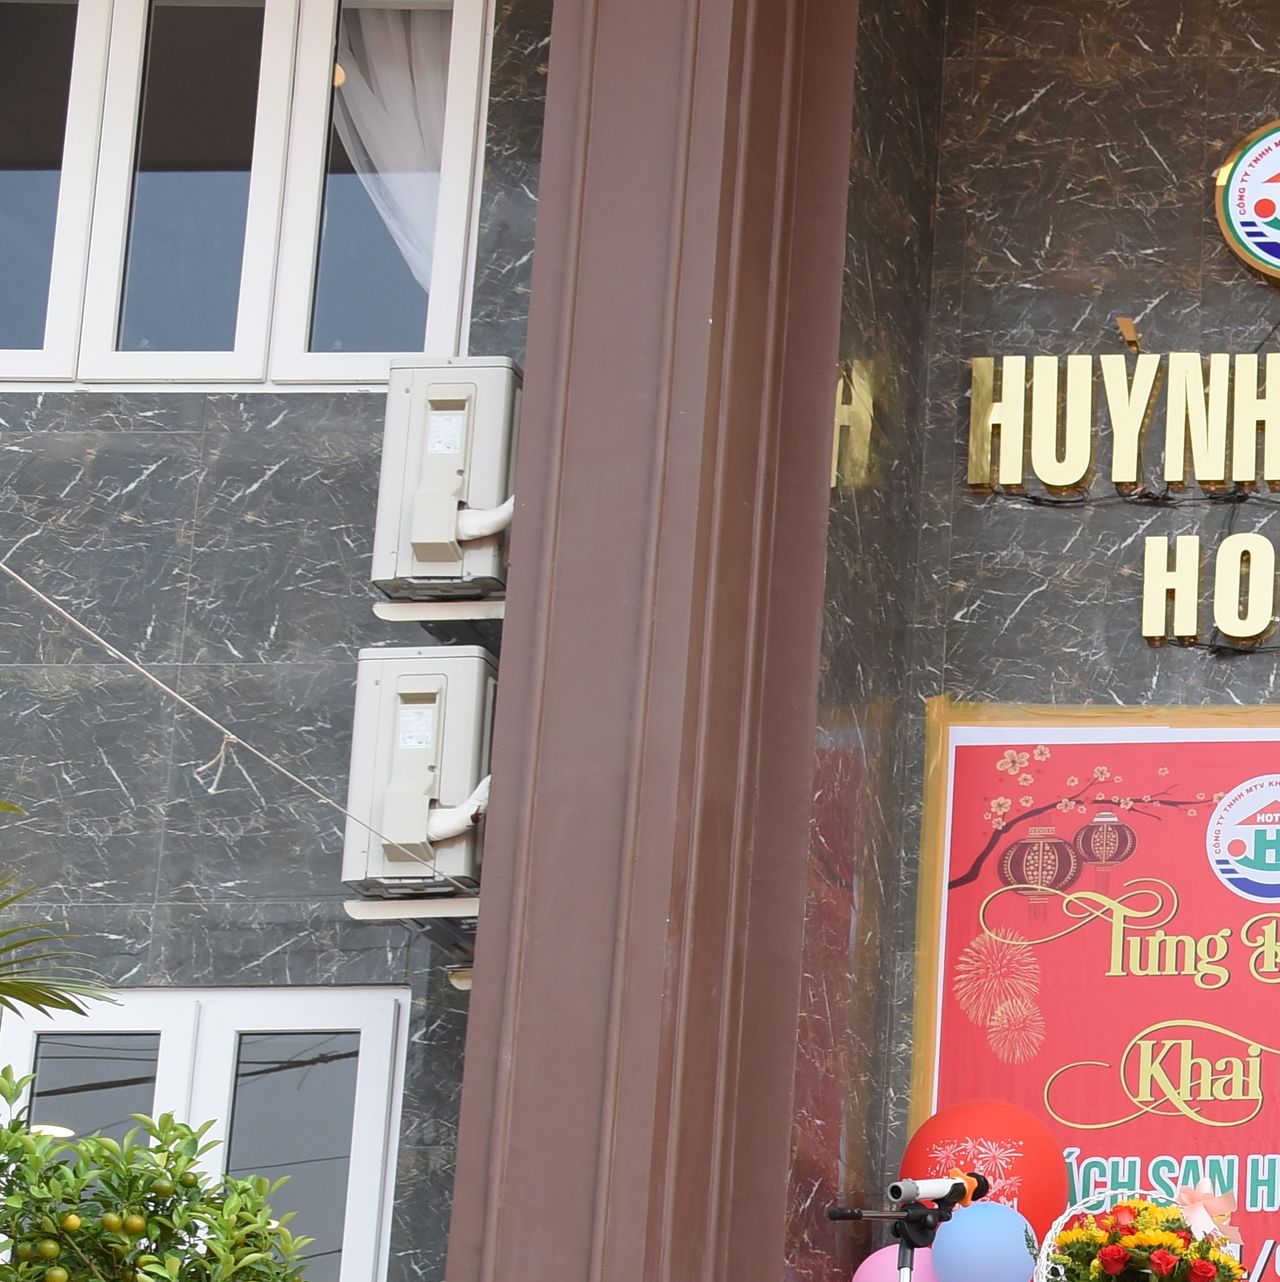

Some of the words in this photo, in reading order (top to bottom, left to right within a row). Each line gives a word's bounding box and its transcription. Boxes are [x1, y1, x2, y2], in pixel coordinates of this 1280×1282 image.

[1248, 145, 1273, 169] TNHH
[1240, 171, 1251, 184] TY
[1236, 187, 1247, 216] CÔNG
[1245, 782, 1265, 794] MTV
[1223, 792, 1245, 813] TNHH
[1216, 815, 1225, 826] TY
[1212, 829, 1222, 855] CÔNG
